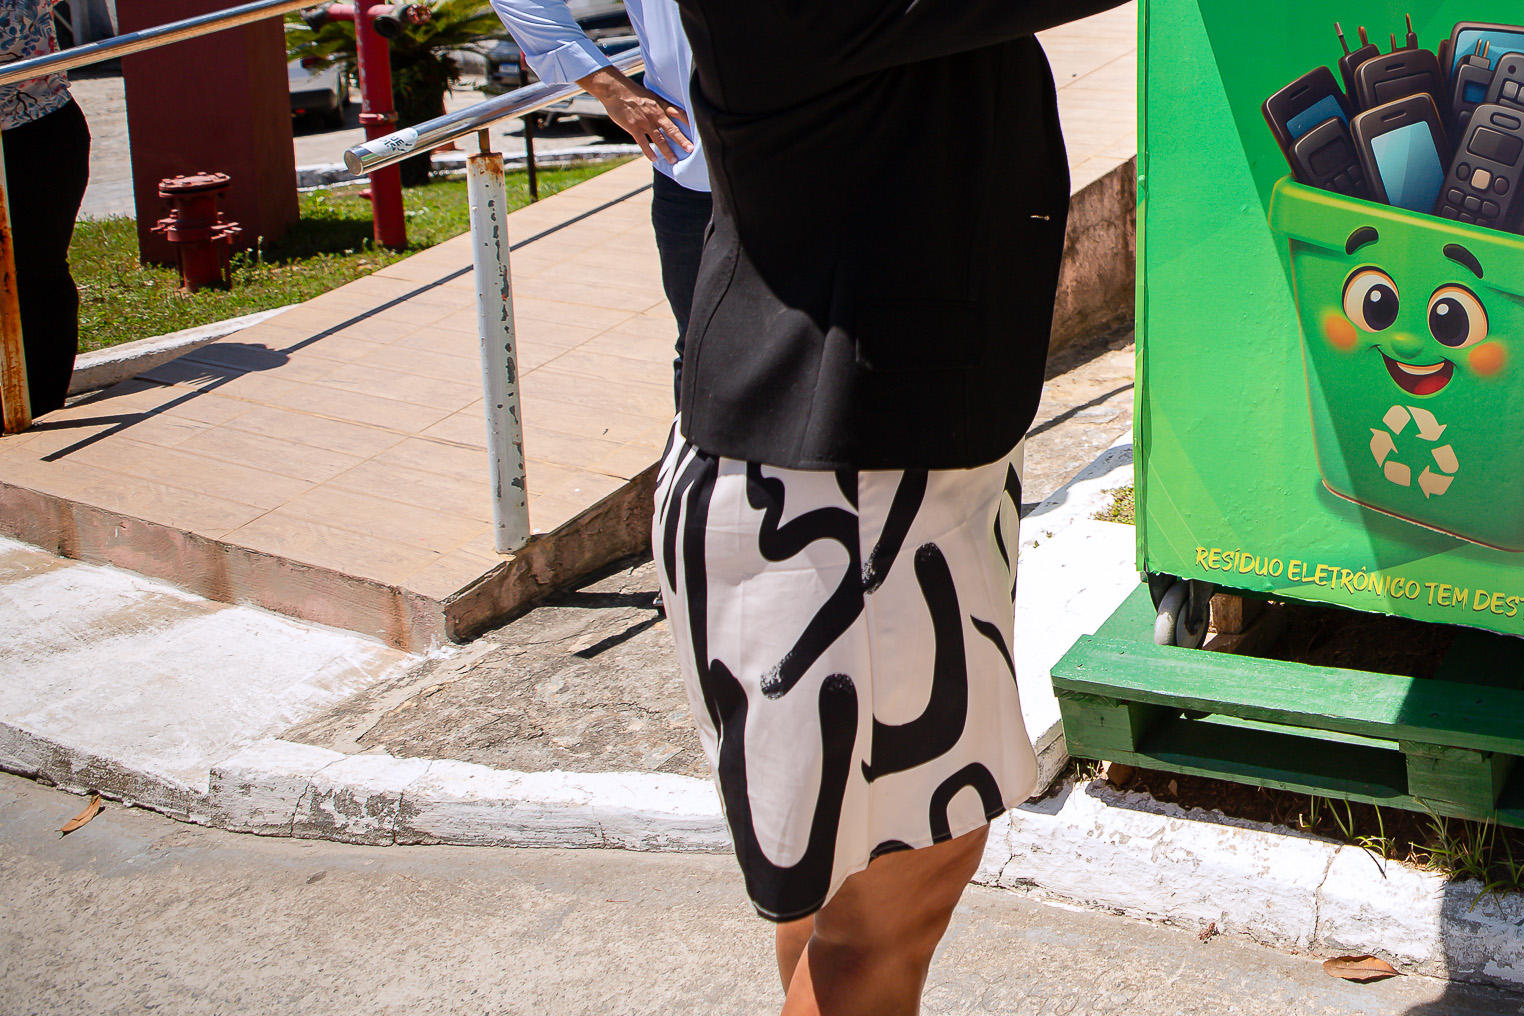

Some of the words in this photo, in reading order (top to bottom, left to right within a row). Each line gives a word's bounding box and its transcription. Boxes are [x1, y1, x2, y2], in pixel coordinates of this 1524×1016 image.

[1195, 546, 1284, 578] RESÍDUO
[1287, 559, 1421, 600] ELETRÔNICO
[1424, 582, 1469, 612] TEM
